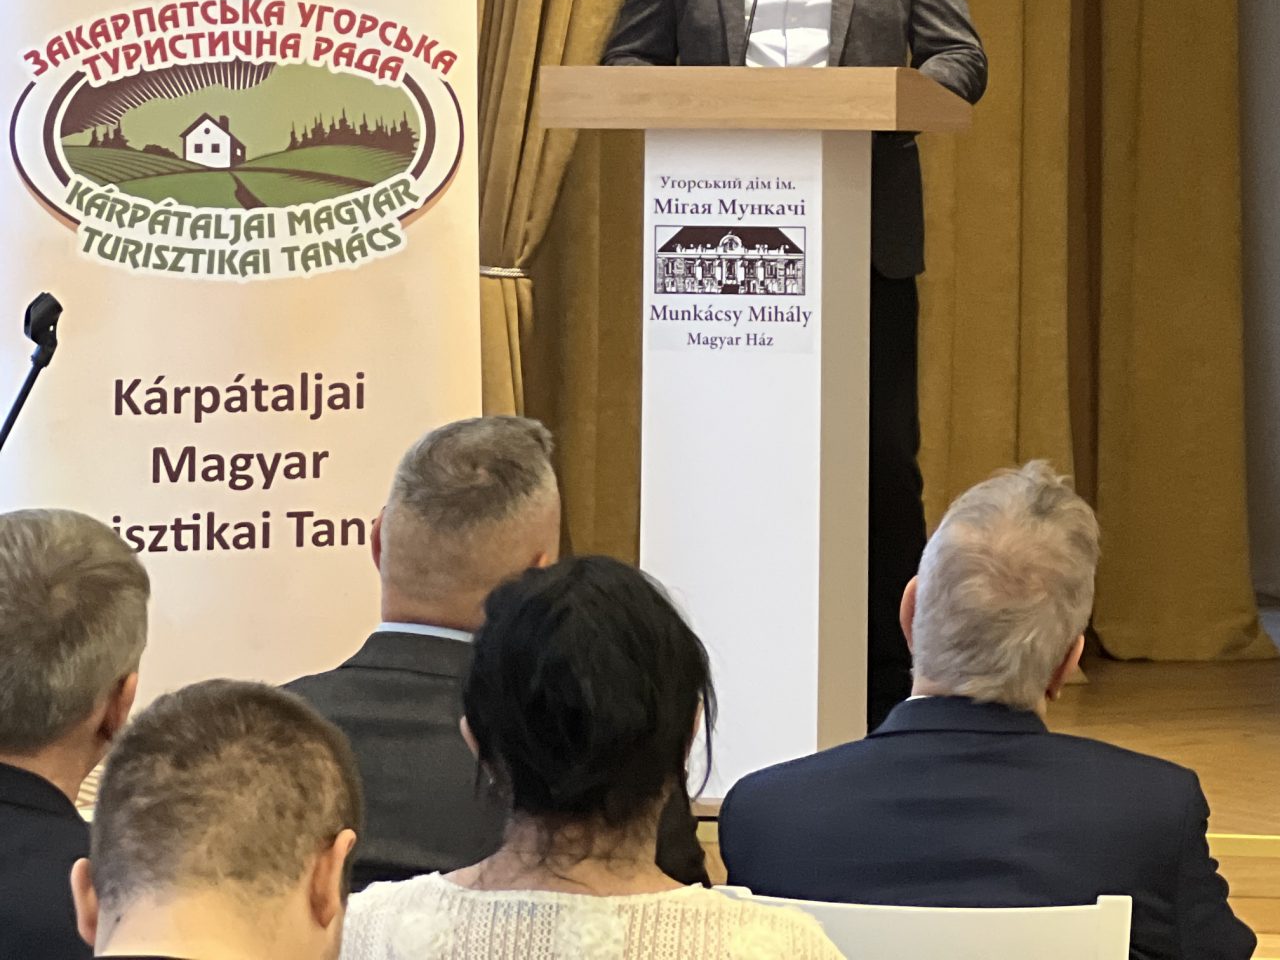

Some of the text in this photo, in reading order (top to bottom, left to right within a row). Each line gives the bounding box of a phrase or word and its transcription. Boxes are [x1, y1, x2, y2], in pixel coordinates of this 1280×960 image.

[82, 30, 405, 83] ТУРИСТИЧНА РАДА
[297, 1, 458, 75] УГОРСЬКА
[660, 175, 796, 193] Угорський дім ім.
[65, 178, 420, 243] KÁRPÁTALJAI MAGYAR
[653, 197, 805, 220] Мігая Мункачі
[82, 222, 402, 278] TURISZTIKAI TANÁCS
[649, 304, 812, 327] Munkácsy Mihály
[686, 332, 774, 348] Magyar Ház
[114, 371, 366, 423] Kárpátaljai
[151, 445, 329, 490] Magyar
[112, 510, 370, 553] isztikai Tan
